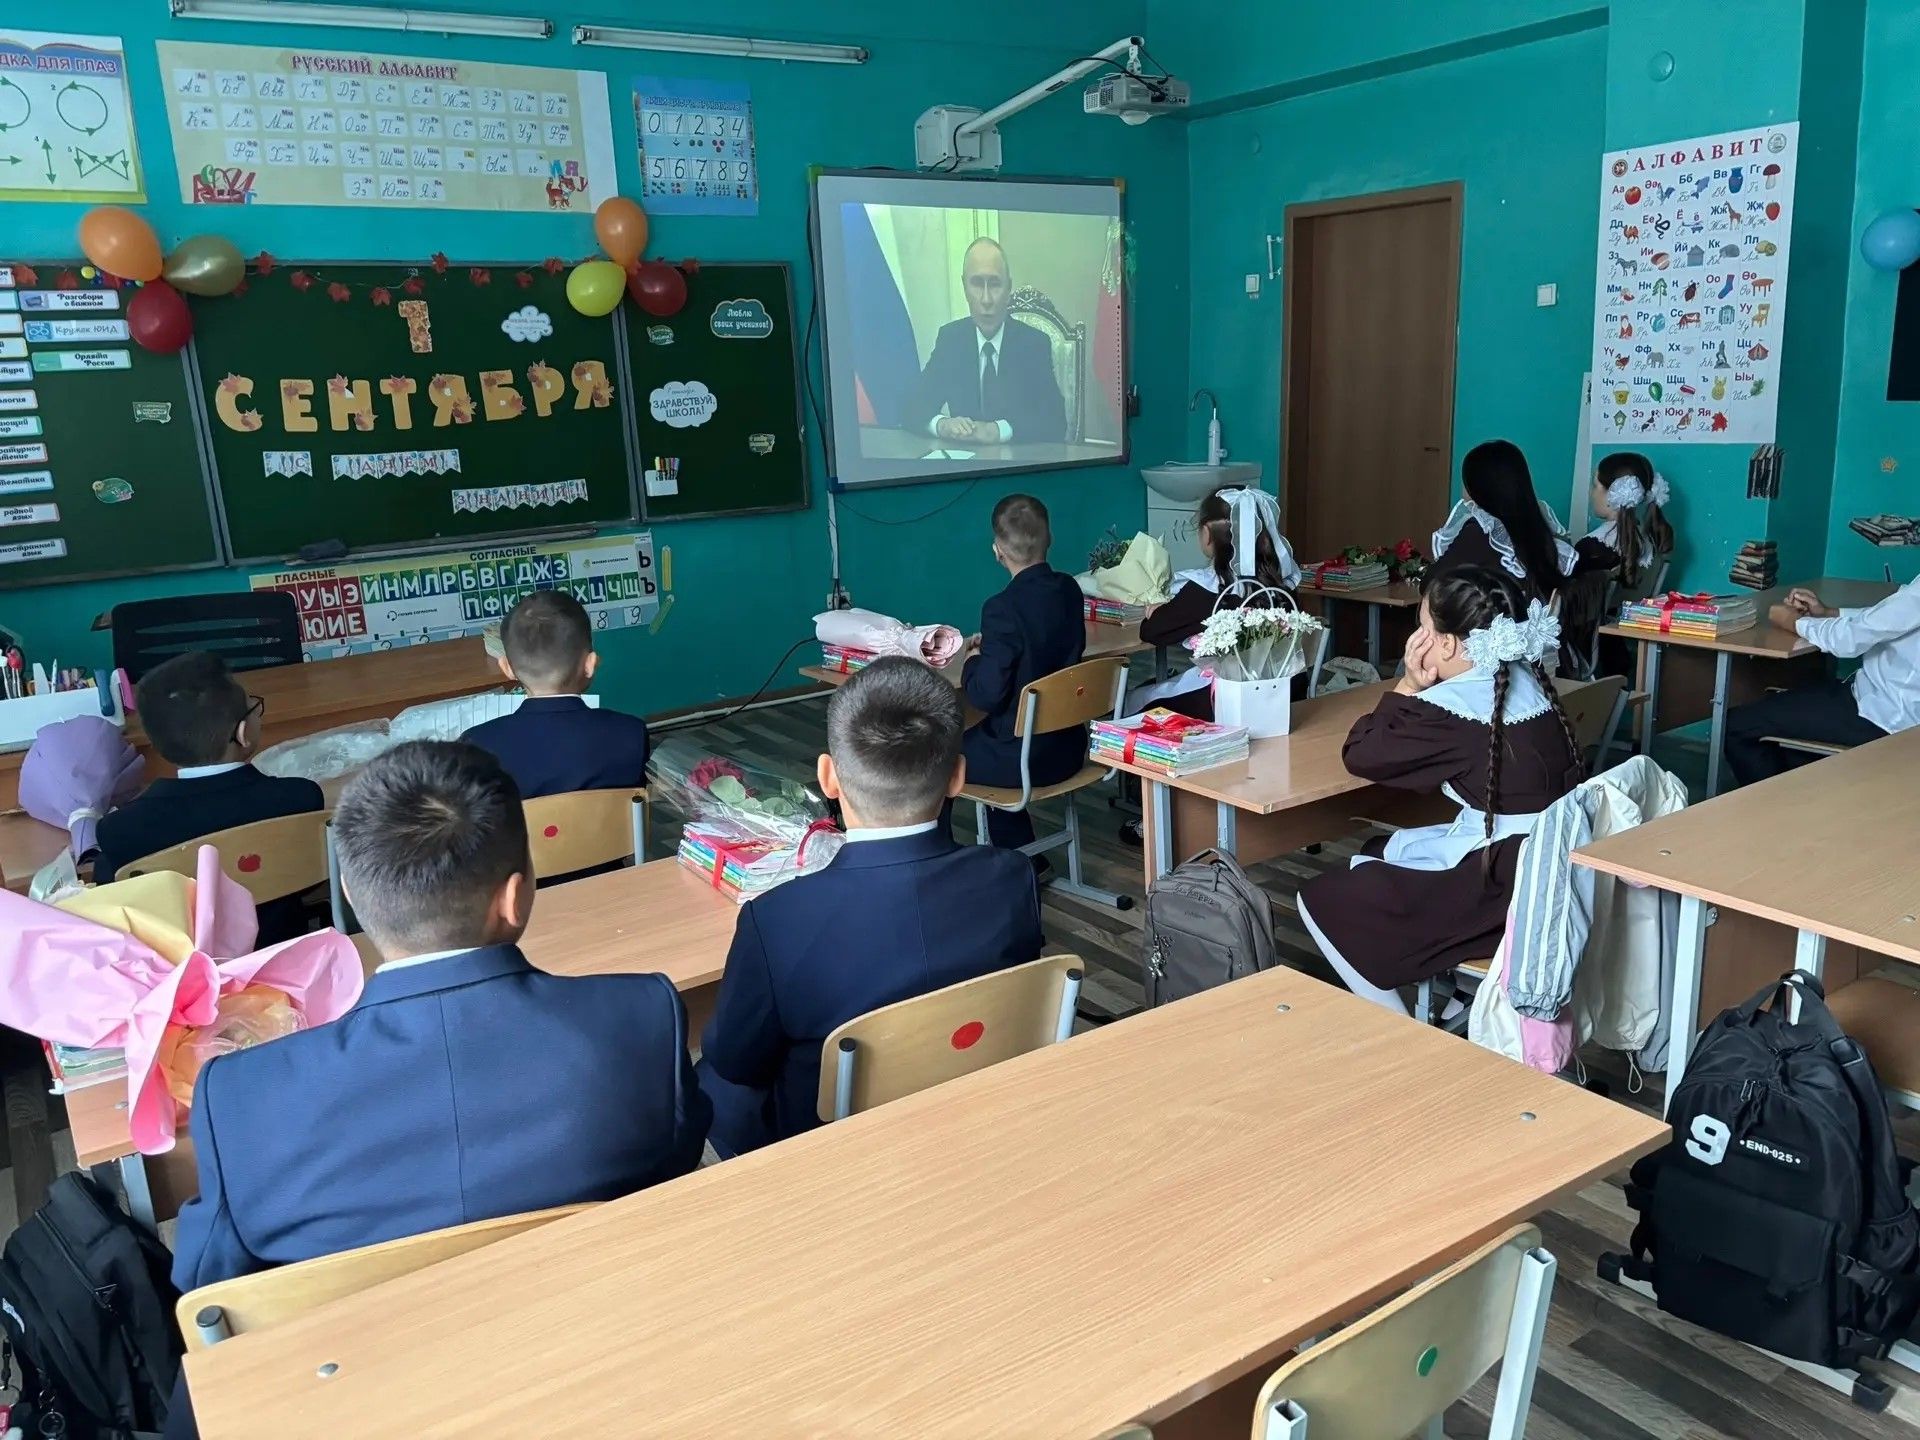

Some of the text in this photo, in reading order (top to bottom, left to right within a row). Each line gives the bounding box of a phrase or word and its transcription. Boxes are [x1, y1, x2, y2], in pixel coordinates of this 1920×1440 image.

[37, 57, 70, 70] ДЛЯ
[76, 59, 116, 72] ГЛАЗ
[292, 55, 457, 80] РУССКИЙ АЛФАВИТ
[649, 113, 744, 137] 0 1 2 3 4
[1633, 138, 1763, 172] АЛФАВИТ
[653, 158, 748, 181] 5 6 7 8 9
[1612, 185, 1625, 194] Аа
[1679, 174, 1693, 184] Бб
[1713, 170, 1728, 179] Вв
[1750, 164, 1761, 174] Гг
[1610, 220, 1624, 230] Дд
[1643, 215, 1654, 224] Ее
[1711, 206, 1727, 215] Жж
[1608, 251, 1619, 260] Зз
[1641, 247, 1654, 256] Ии
[1708, 239, 1720, 248] Кк
[1744, 235, 1759, 245] Лл
[1607, 284, 1621, 293] Мм
[1639, 281, 1652, 290] Нн
[1706, 274, 1720, 284] Оо
[57, 293, 103, 301] Разговоры
[727, 308, 752, 317] Люблю
[1605, 303, 1752, 322] Пп Рр Сс Тт Уу
[55, 325, 118, 335] Кружок ЮИД
[398, 301, 432, 353] 1
[714, 320, 769, 329] своих учеников!
[75, 353, 108, 361] Орлята
[1635, 345, 1652, 354] Фф
[1668, 343, 1680, 352] Хх
[1633, 377, 1651, 385] Шш
[1667, 375, 1685, 385] Щщ
[1735, 372, 1754, 381] Ыы
[215, 360, 614, 432] СЕНТЯБРЯ
[666, 406, 705, 418] ШКОЛА!
[1665, 407, 1684, 416] Юю
[1697, 408, 1711, 417] Яя
[4, 507, 33, 517] родной
[470, 546, 536, 561] СОГЛАСНЫЕ
[275, 569, 336, 584] ГЛАСНЫЕ
[597, 606, 641, 629] 8 9
[1685, 1114, 1732, 1166] 9
